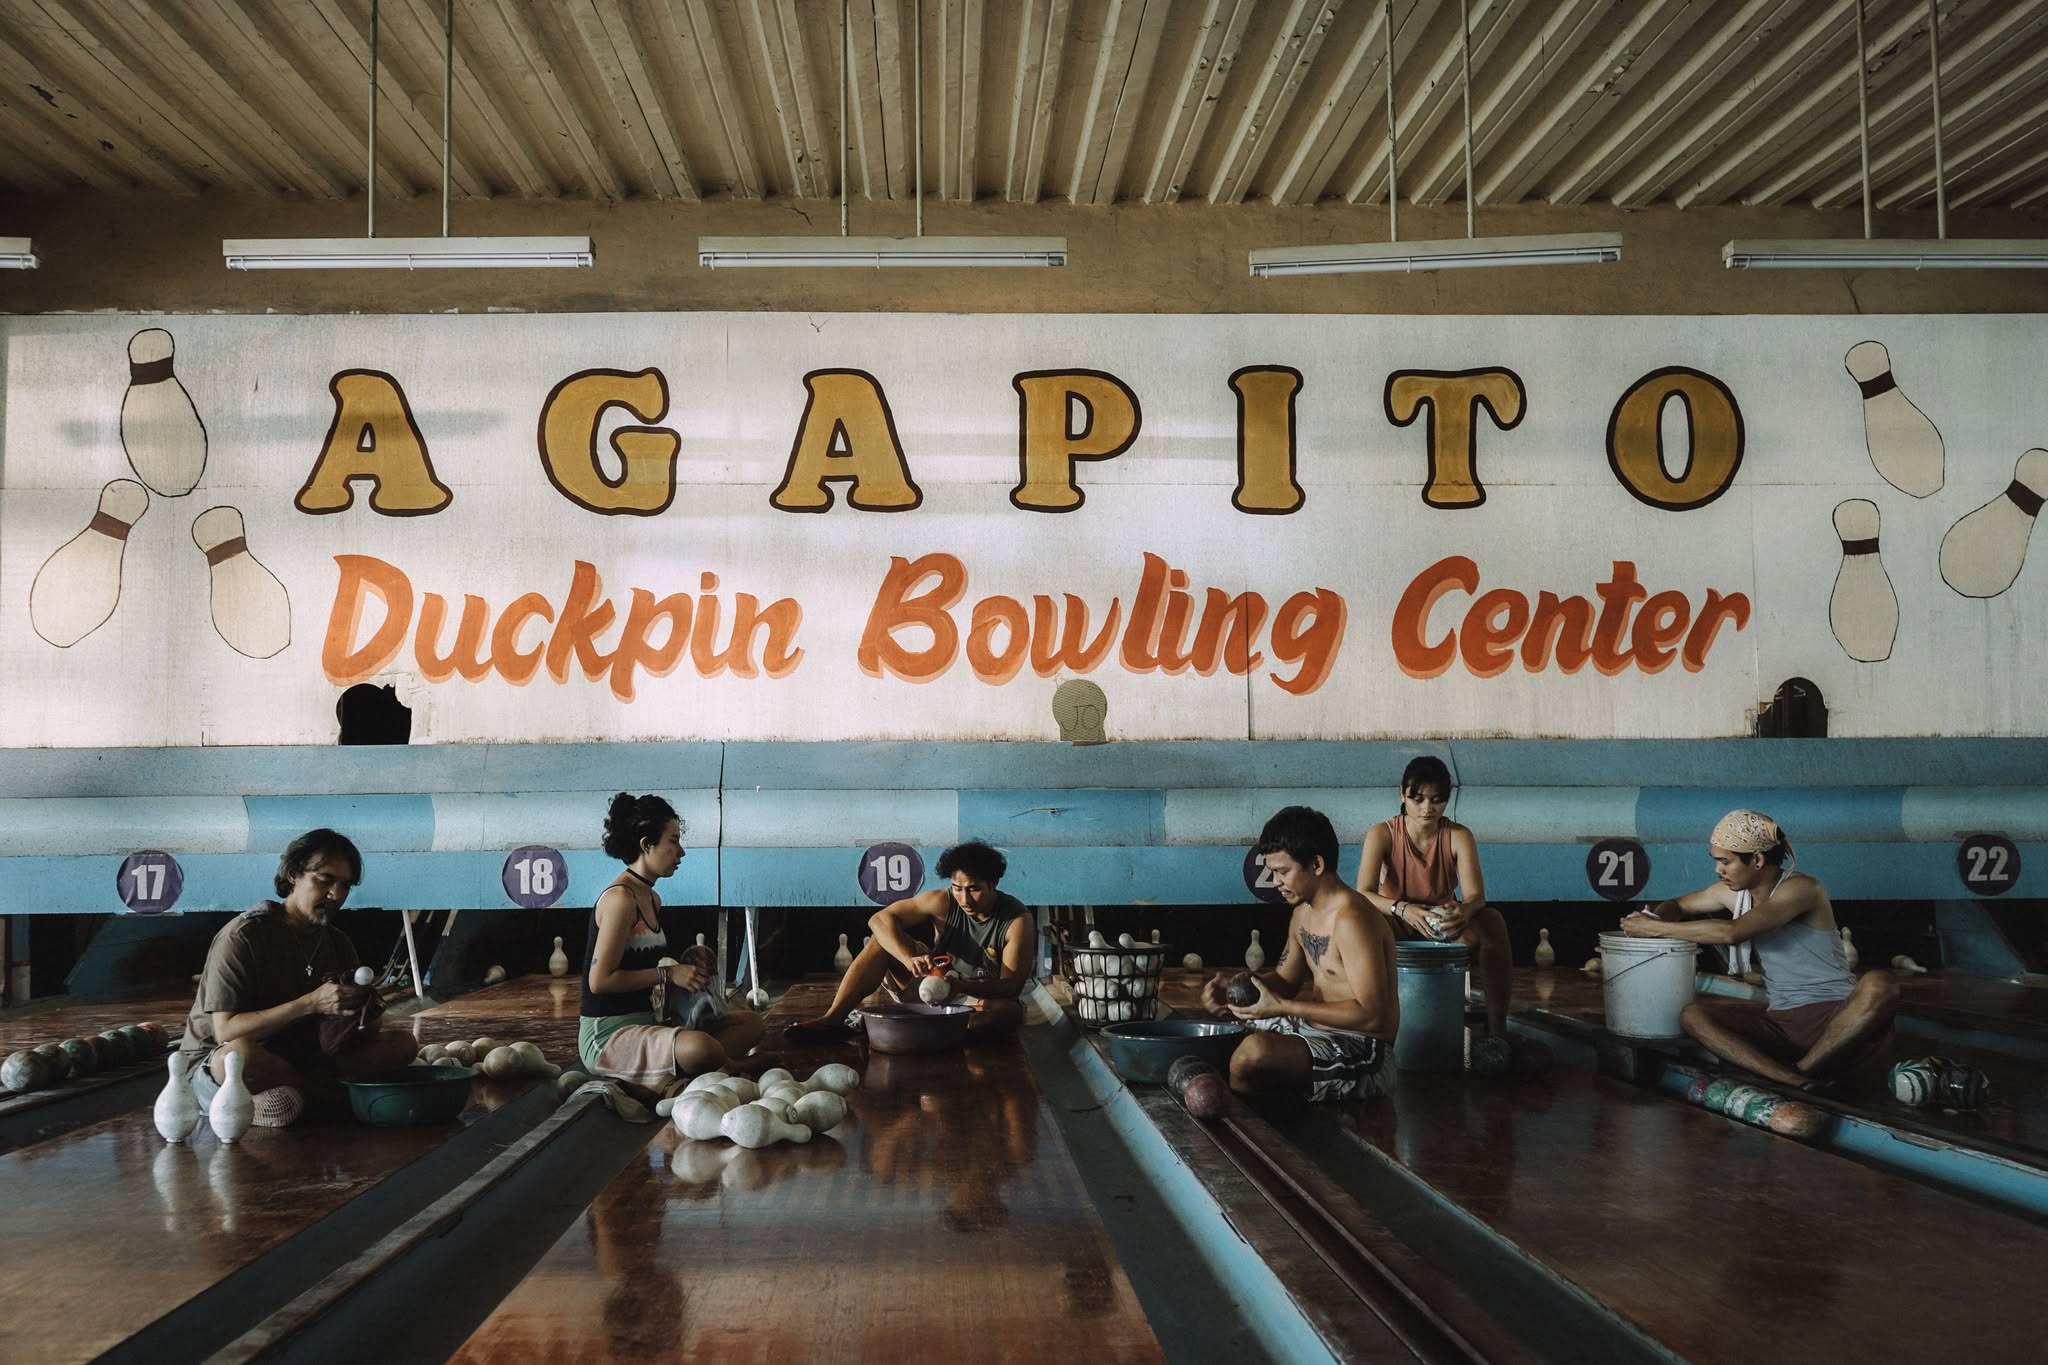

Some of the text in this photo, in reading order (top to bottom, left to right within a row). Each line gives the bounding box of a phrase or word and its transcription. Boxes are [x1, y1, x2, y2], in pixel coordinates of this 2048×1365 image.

[294, 364, 1746, 517] AGAPITO
[321, 552, 1749, 704] Duckpin Bowling Center
[514, 858, 554, 895] 18
[870, 854, 911, 892] 19
[1254, 853, 1275, 889] 2
[1598, 850, 1634, 886] 21
[1967, 846, 2009, 881] 22
[131, 864, 166, 900] 17
